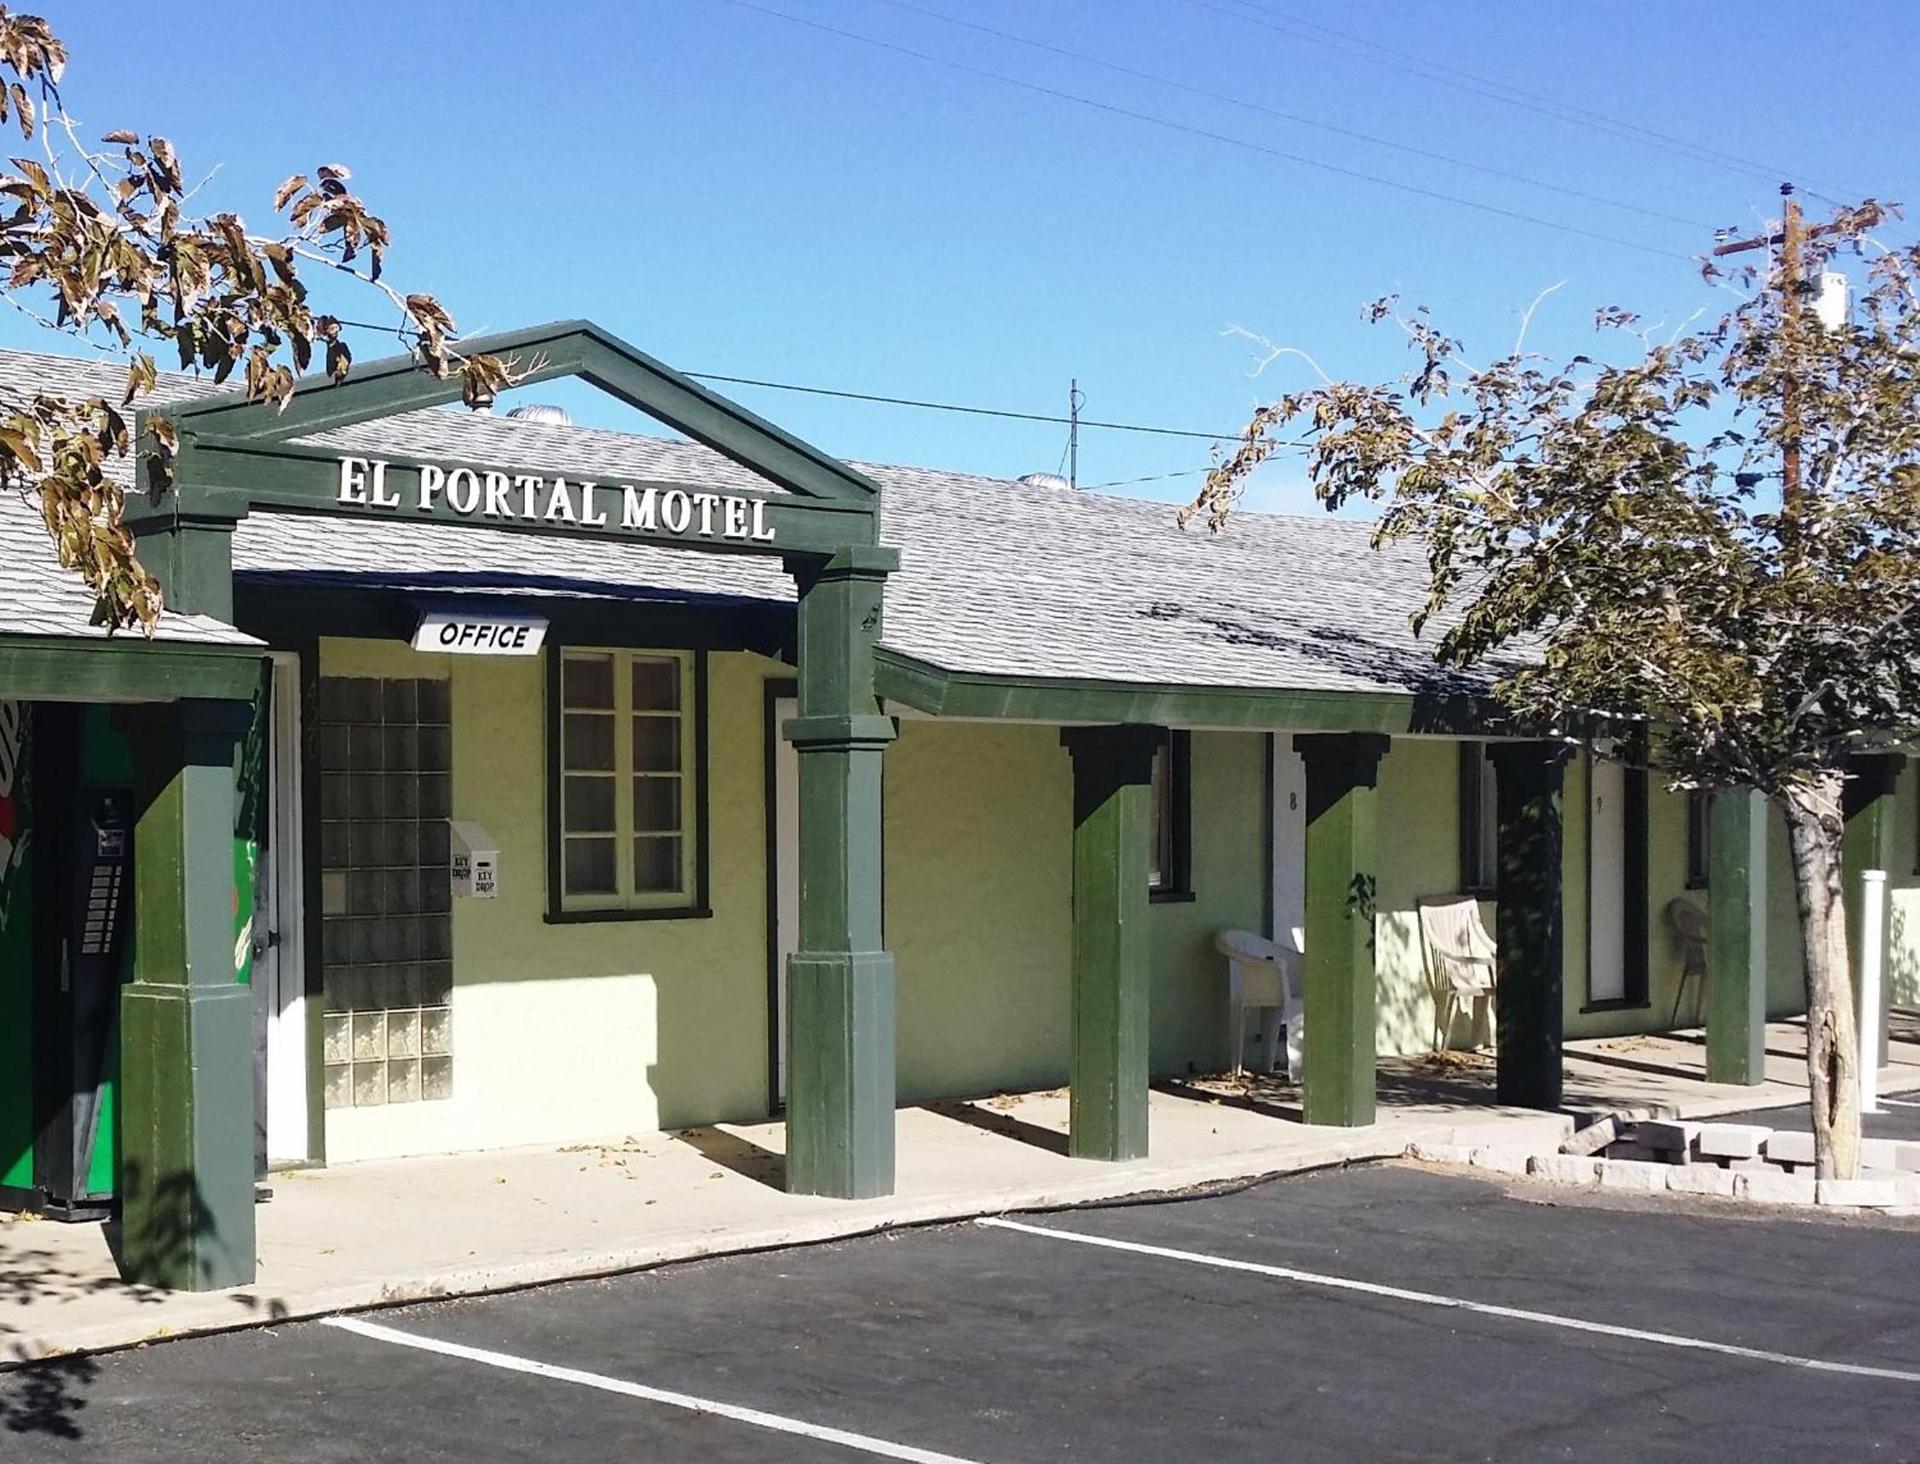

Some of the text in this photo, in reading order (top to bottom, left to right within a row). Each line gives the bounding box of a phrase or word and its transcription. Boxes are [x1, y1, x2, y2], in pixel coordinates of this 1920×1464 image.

[336, 456, 776, 541] EL PORTAL MOTEL
[439, 622, 530, 649] OFFICE
[1289, 791, 1298, 811] 8
[1596, 796, 1603, 815] 9
[478, 872, 493, 881] KEY
[475, 882, 495, 892] DROP
